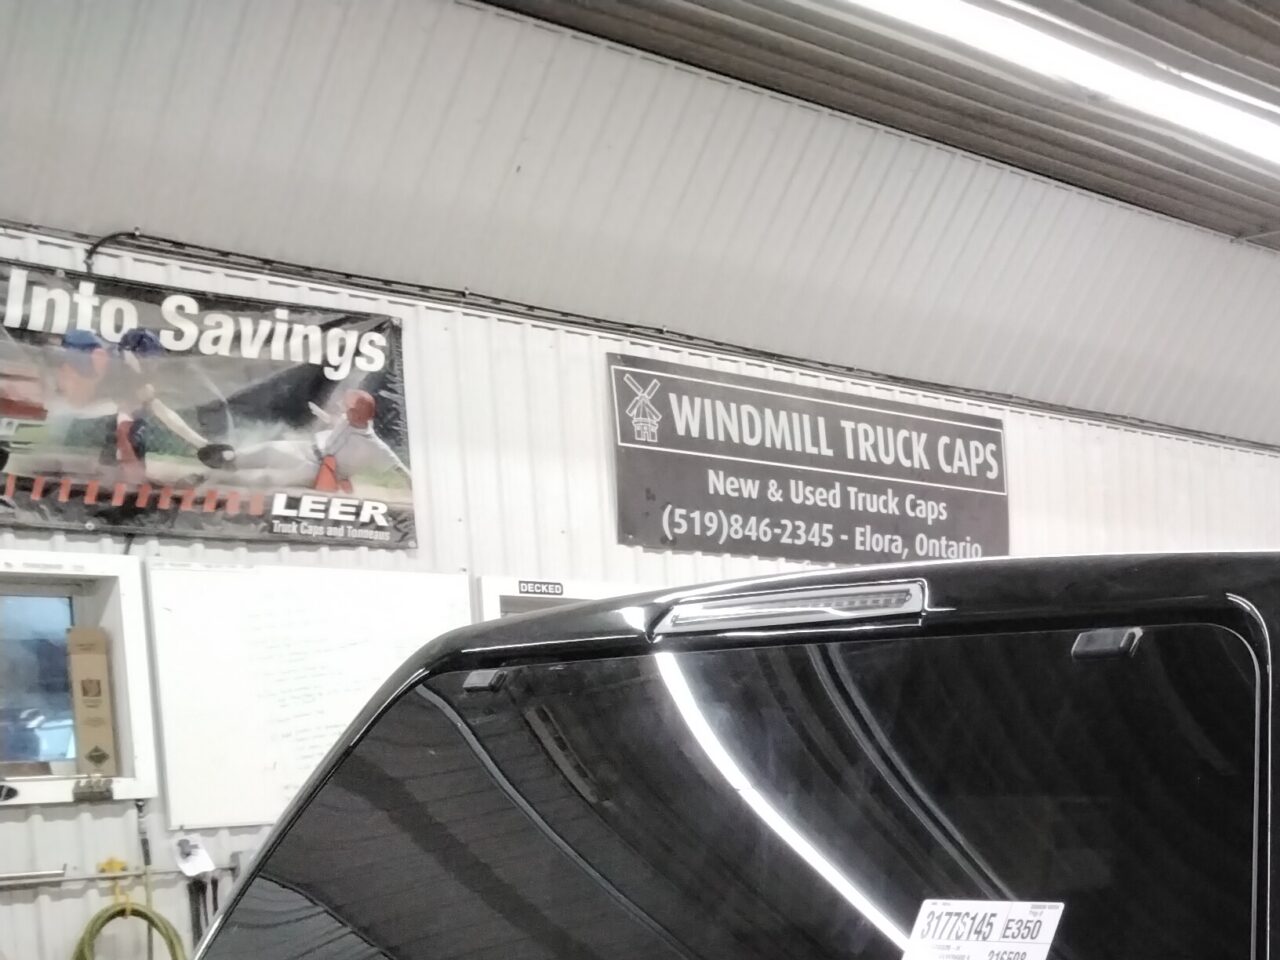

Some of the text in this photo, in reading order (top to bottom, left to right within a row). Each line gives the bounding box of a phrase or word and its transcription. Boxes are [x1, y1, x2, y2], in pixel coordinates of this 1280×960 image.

[4, 268, 387, 380] Into Savings
[668, 393, 999, 480] WINDMILL TRUCK CAPS
[271, 493, 389, 527] LEER
[708, 469, 948, 526] New & Used Truck Caps
[272, 520, 298, 534] Truck
[300, 522, 325, 537] Caps
[326, 525, 345, 537] and
[661, 504, 834, 549] (519)846-2345
[854, 526, 909, 560] Elora,
[915, 536, 983, 560] Ontario
[520, 582, 562, 594] DECKED
[1002, 918, 1043, 940] E350
